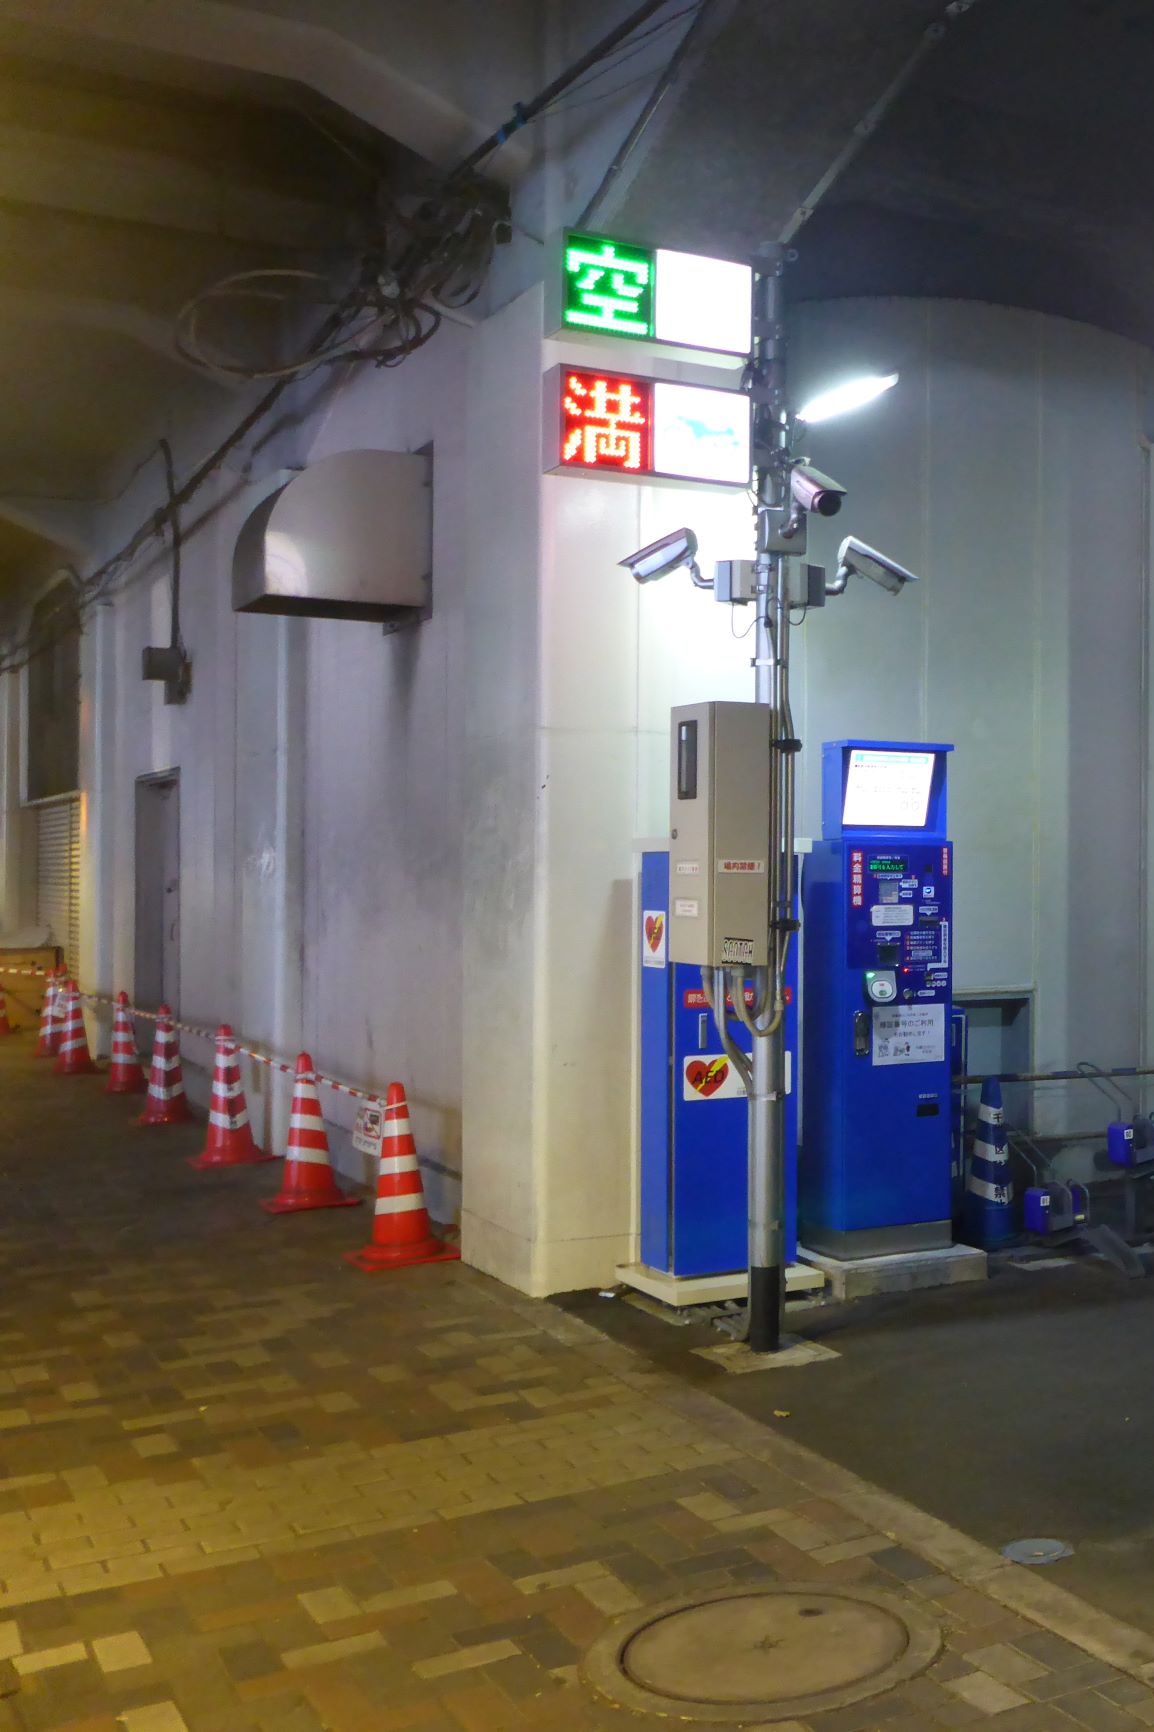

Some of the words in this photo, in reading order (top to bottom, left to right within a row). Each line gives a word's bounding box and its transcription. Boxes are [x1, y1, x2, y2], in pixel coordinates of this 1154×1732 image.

[565, 245, 650, 336] 空
[563, 376, 645, 470] 満
[693, 1070, 724, 1084] AED
